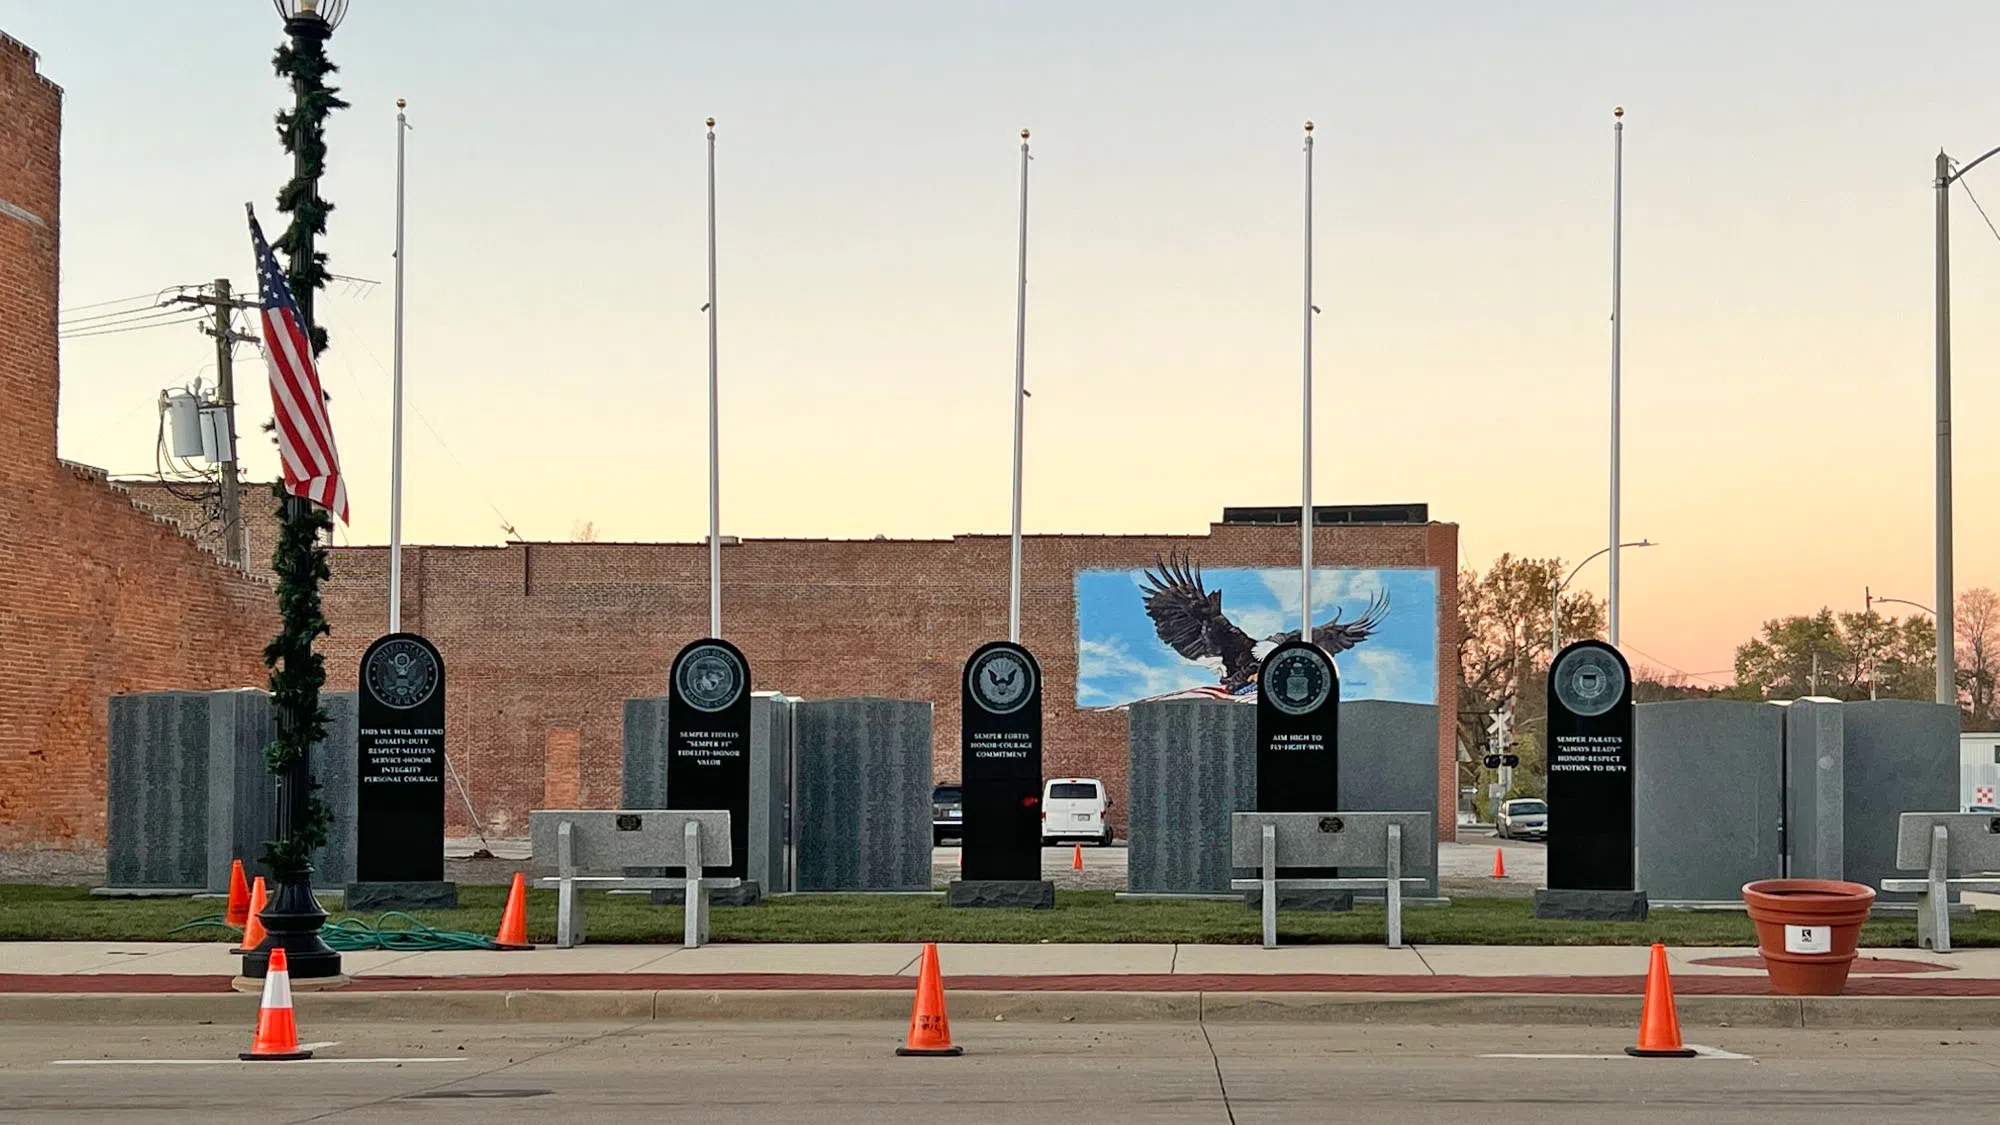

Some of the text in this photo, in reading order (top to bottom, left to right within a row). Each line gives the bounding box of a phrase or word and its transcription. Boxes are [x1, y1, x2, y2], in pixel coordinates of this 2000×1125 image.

[1551, 764, 1627, 772] DEVOTION TO DUTY
